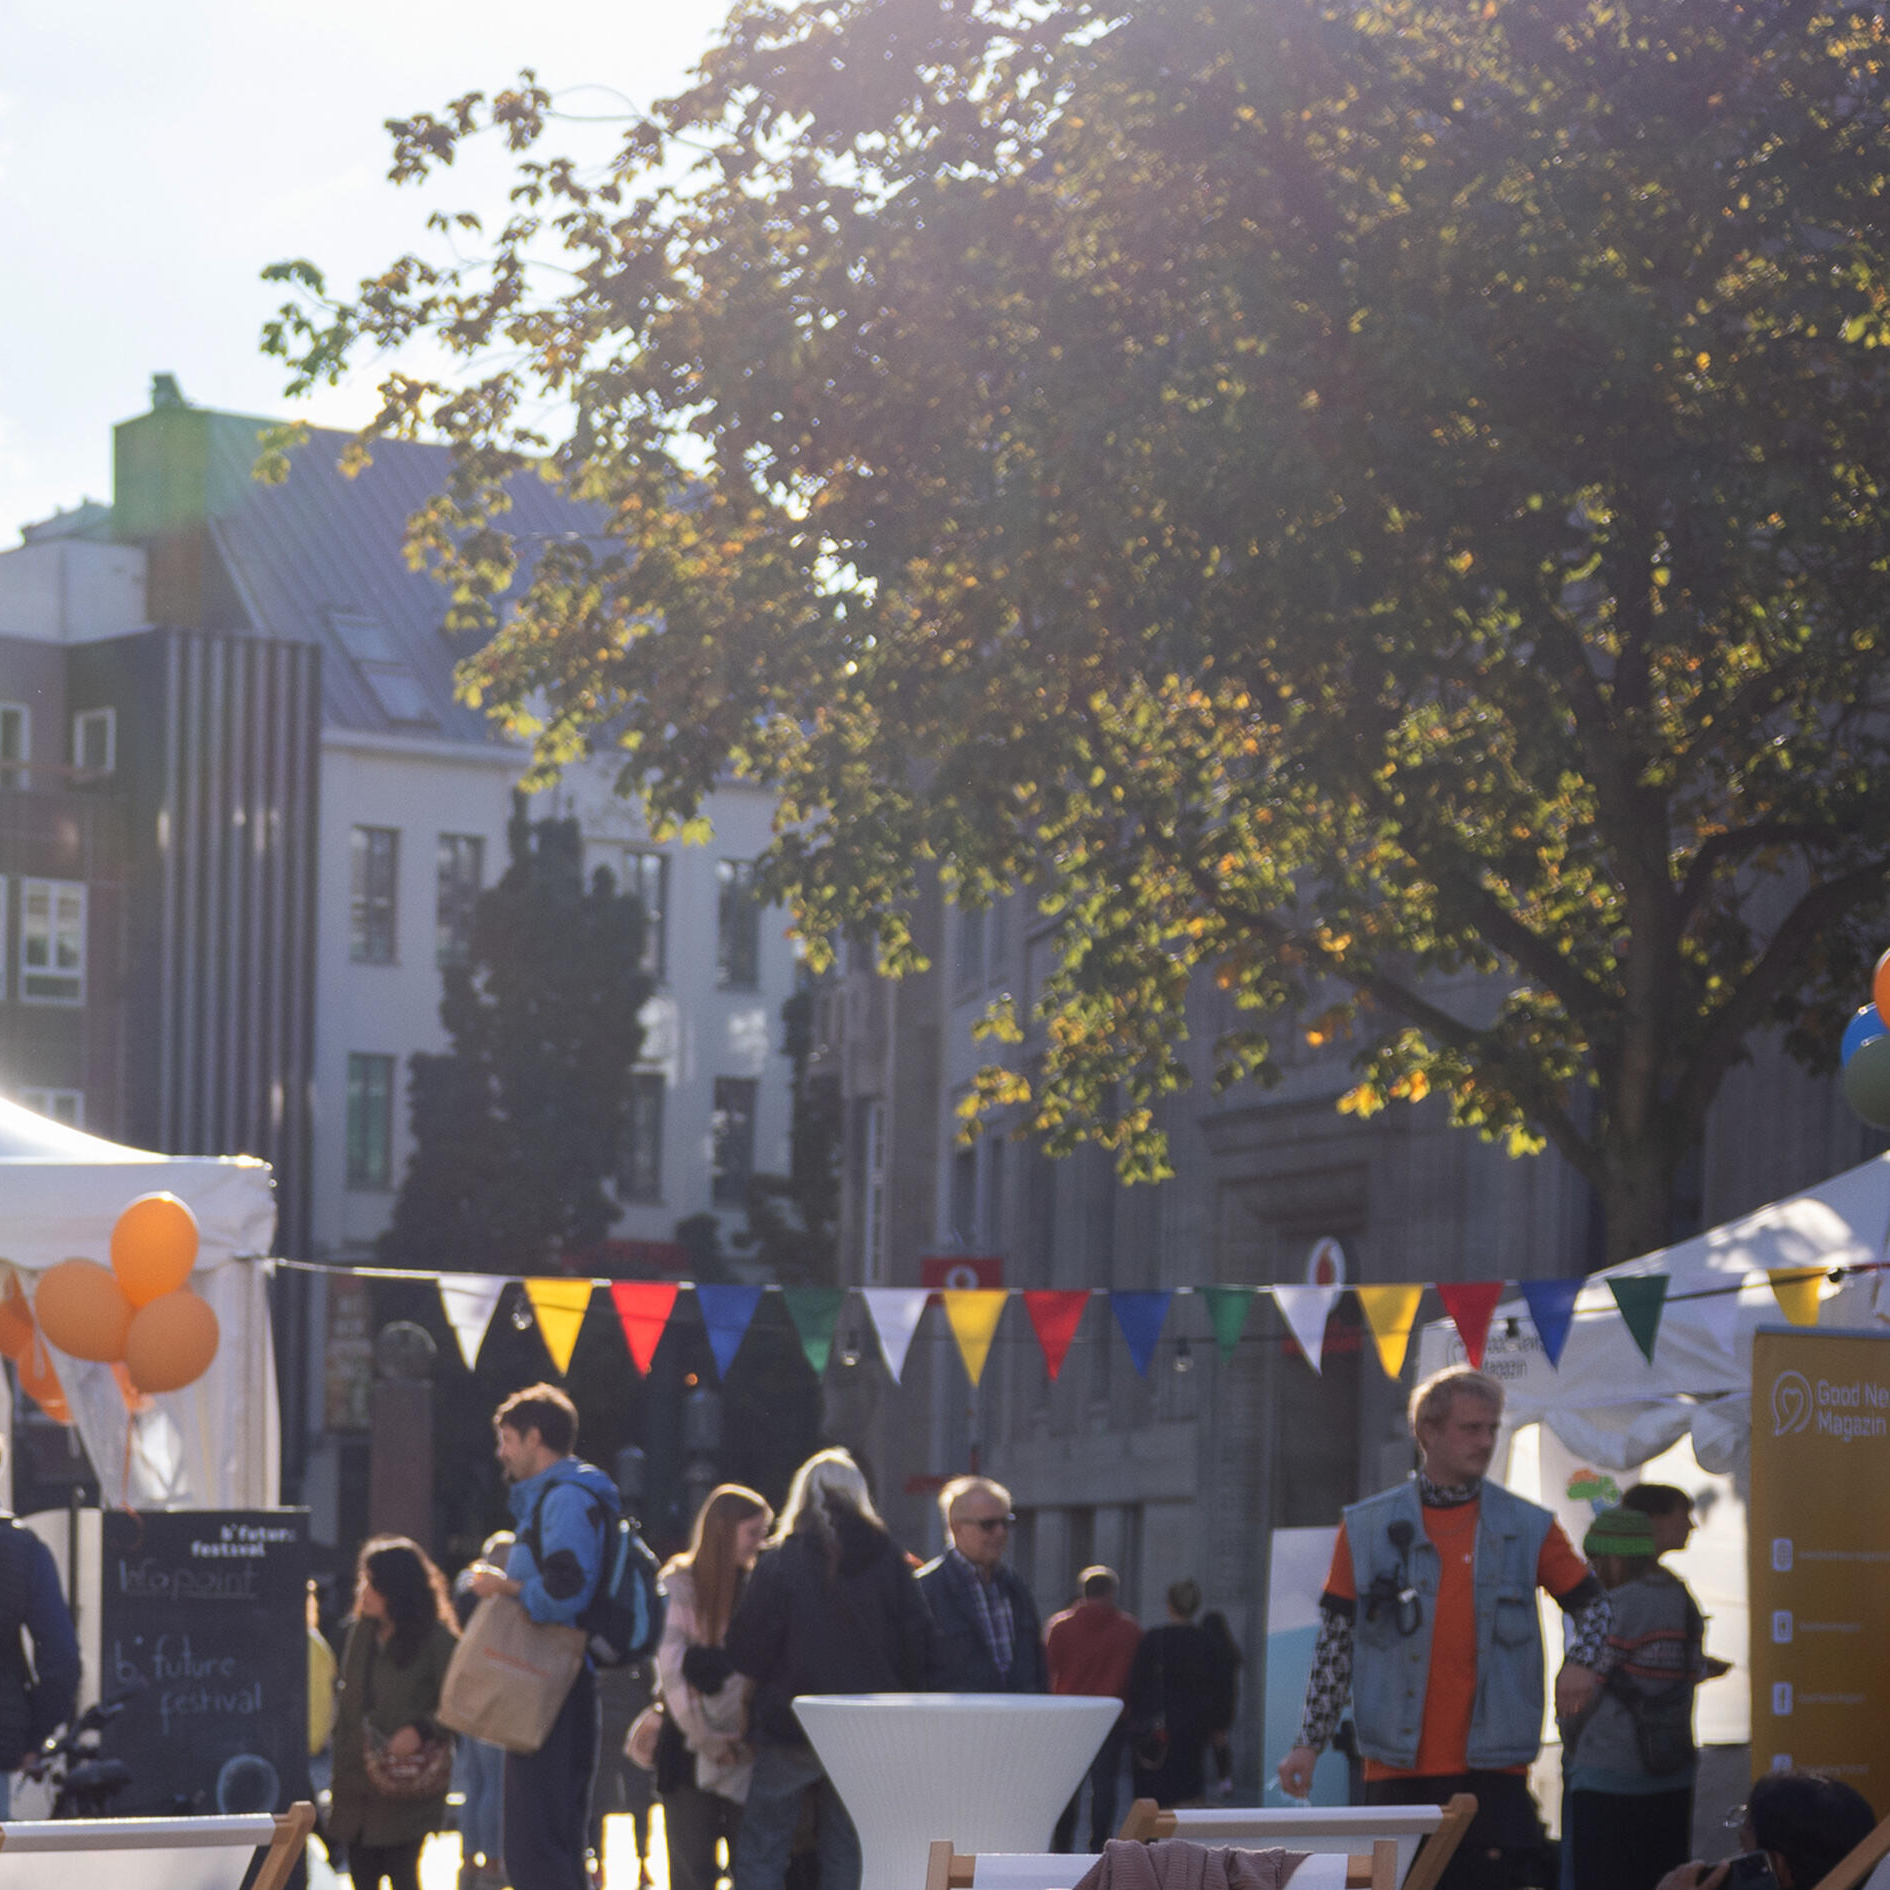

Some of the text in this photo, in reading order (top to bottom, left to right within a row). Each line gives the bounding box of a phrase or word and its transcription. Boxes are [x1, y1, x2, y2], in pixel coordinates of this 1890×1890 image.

[1816, 1378, 1862, 1406] Good
[1816, 1409, 1888, 1443] Magazin
[191, 1539, 267, 1557] festival
